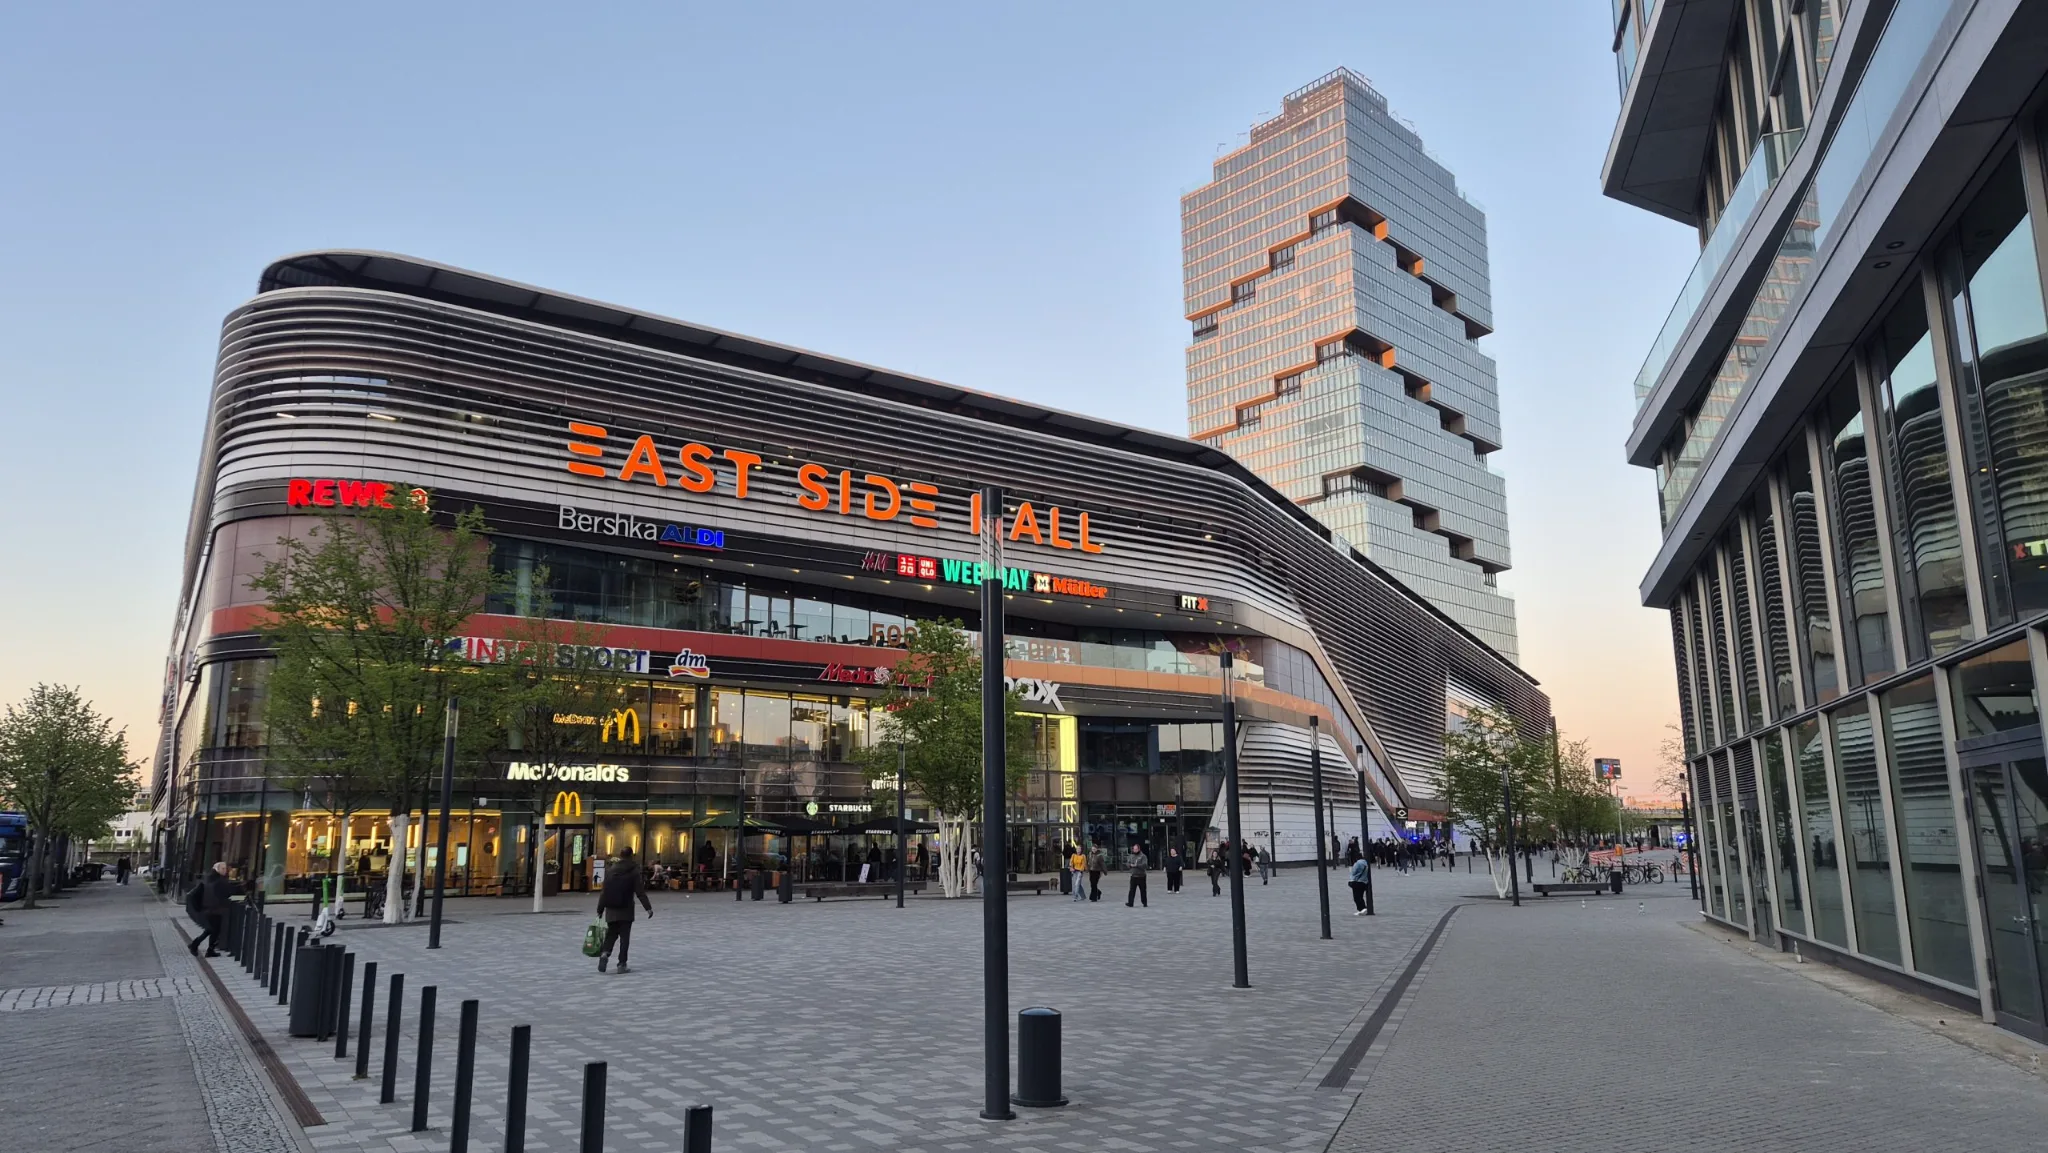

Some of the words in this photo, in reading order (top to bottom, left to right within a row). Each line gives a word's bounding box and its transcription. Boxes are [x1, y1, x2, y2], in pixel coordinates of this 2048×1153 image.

[567, 421, 761, 499] EAST
[798, 463, 938, 528] SIDE
[288, 478, 395, 509] REWE
[558, 505, 657, 541] Bershka
[660, 524, 724, 548] ALDI
[920, 560, 934, 568] UNI
[920, 568, 935, 577] QLO
[1053, 576, 1107, 598] Müller
[1181, 594, 1209, 611] FITX
[871, 622, 919, 648] FOO
[466, 637, 648, 672] INTERSPORT
[677, 650, 704, 667] dm
[506, 762, 630, 782] McDonald's
[829, 804, 872, 812] STARBUCKS
